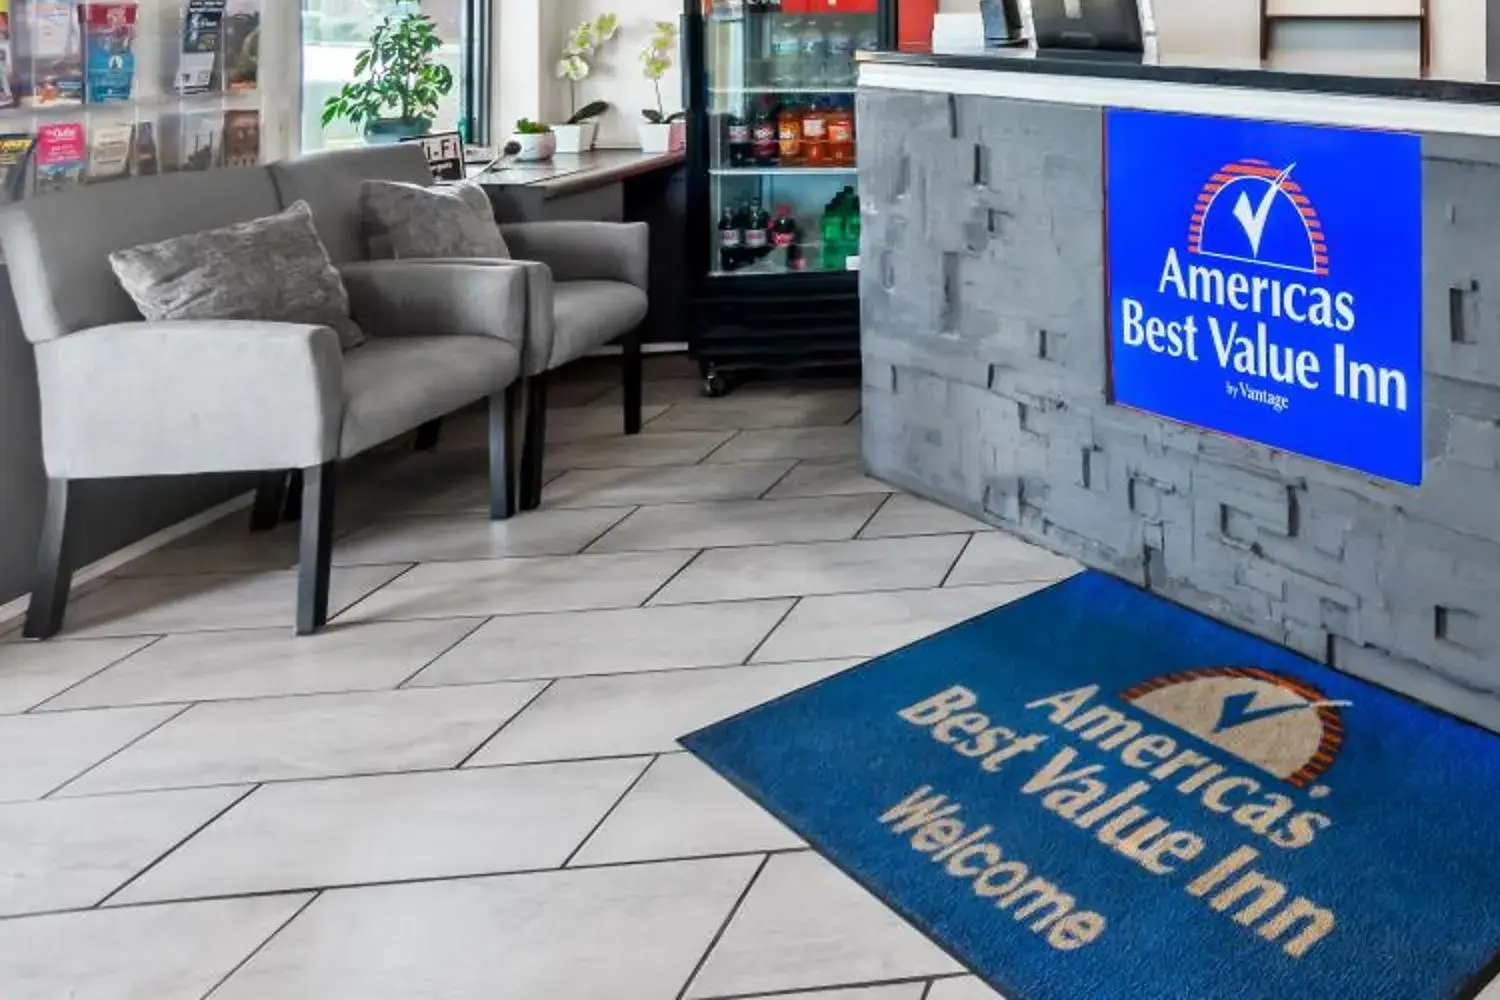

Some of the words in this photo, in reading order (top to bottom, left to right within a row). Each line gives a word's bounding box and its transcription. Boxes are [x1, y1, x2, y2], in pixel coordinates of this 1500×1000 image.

[1122, 297, 1199, 362] Best
[1208, 315, 1321, 390] Value
[1334, 343, 1408, 413] Inn
[1158, 247, 1356, 332] Americas
[1239, 381, 1289, 413] Vantage
[897, 685, 1046, 772] Best
[1021, 746, 1204, 876] Value
[1183, 844, 1336, 959] Inn
[1025, 684, 1330, 849] Americas
[877, 784, 1107, 951] Welcome
